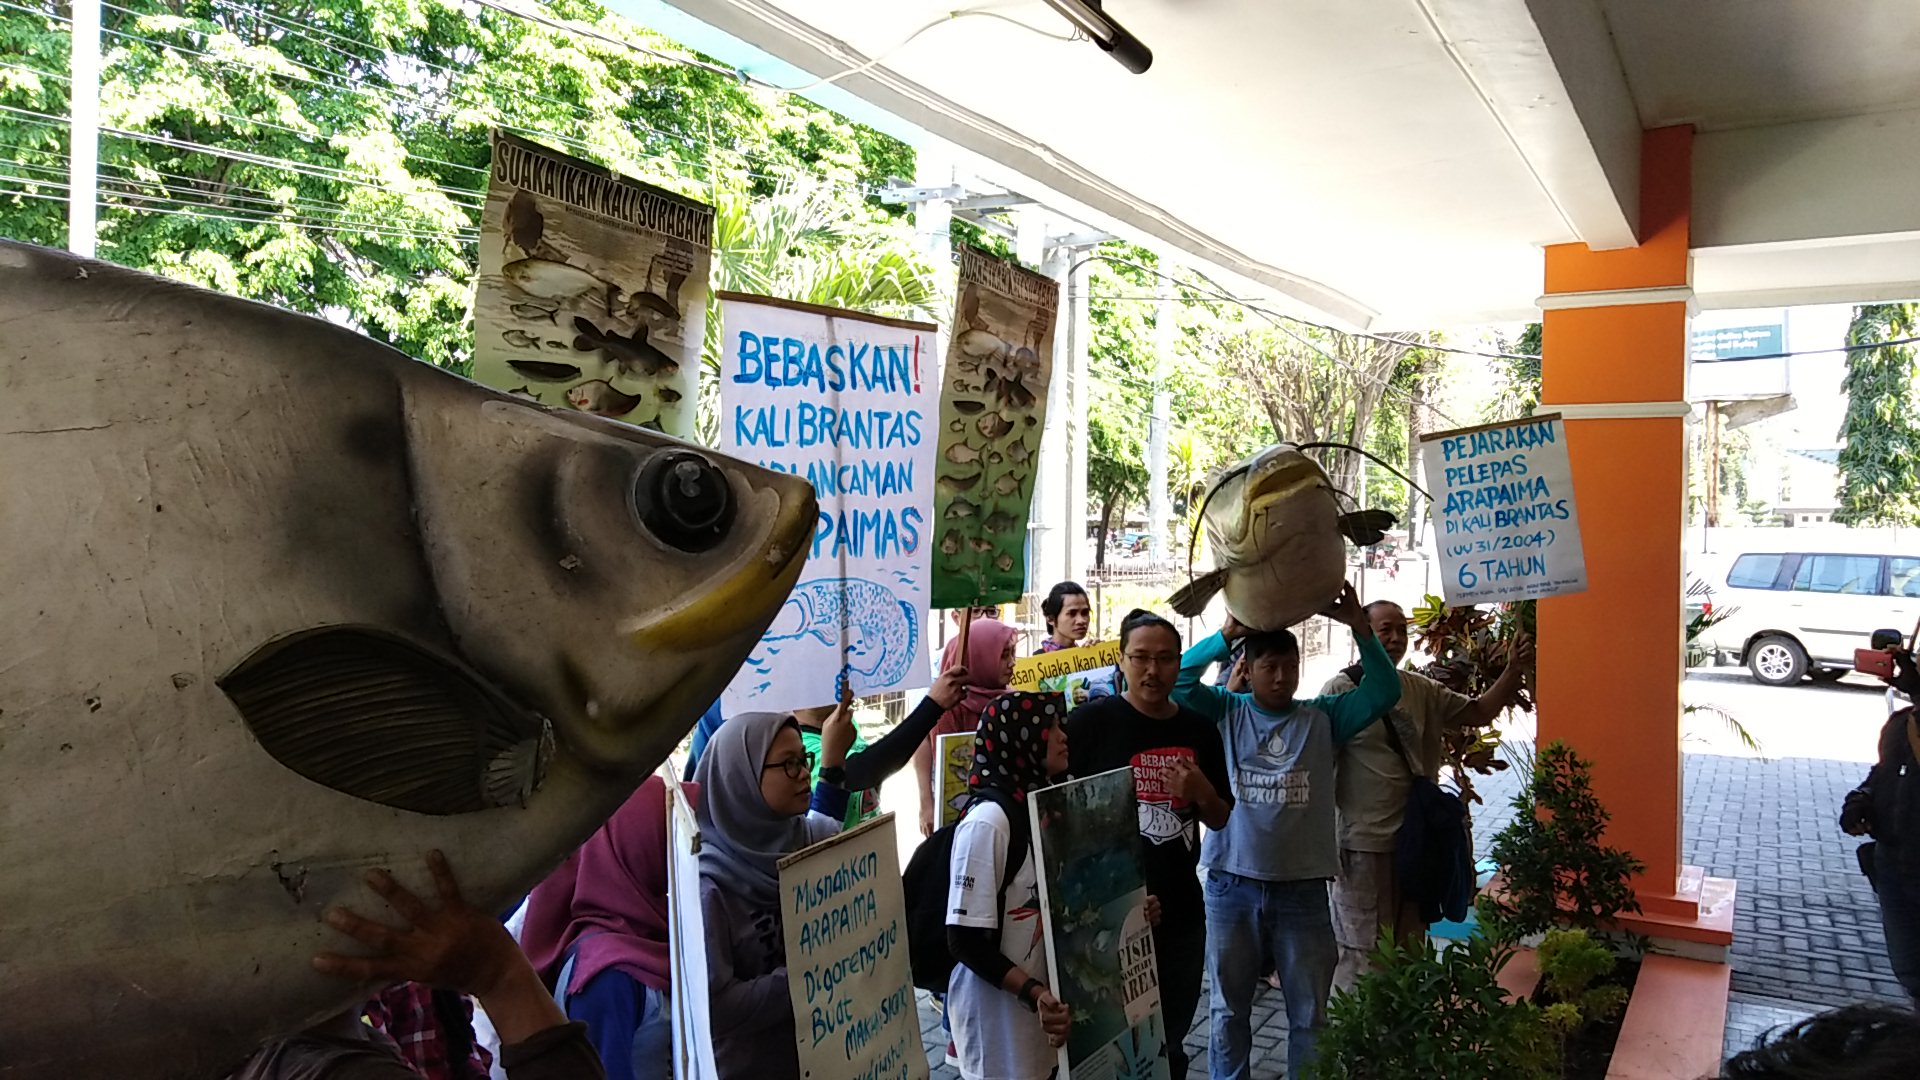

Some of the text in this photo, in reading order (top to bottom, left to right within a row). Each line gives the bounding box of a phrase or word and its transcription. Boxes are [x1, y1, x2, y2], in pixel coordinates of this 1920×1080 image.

[496, 141, 711, 248] SUAKA IKAN KALI SURABAYA
[733, 330, 921, 397] BEBASKAN!
[736, 400, 923, 450] KALI BRANTAS
[1441, 420, 1555, 462] PEJARAKAN
[806, 456, 913, 500] ANCAMAN
[1445, 454, 1528, 488] PELEPAS
[1442, 476, 1550, 517] ARAPAIMA
[1446, 519, 1459, 535] DI
[1495, 499, 1569, 529] BRANTAS
[806, 506, 923, 560] PAIMAS
[1458, 554, 1546, 589] 6 TAHUN
[1010, 647, 1120, 686] asan Suaka Ikan Kali
[1140, 753, 1193, 768] BEBASKN
[1136, 779, 1161, 793] DARI
[800, 888, 877, 956] ARAPAIMA
[1117, 934, 1152, 970] FISH
[1121, 967, 1159, 1008] AREA
